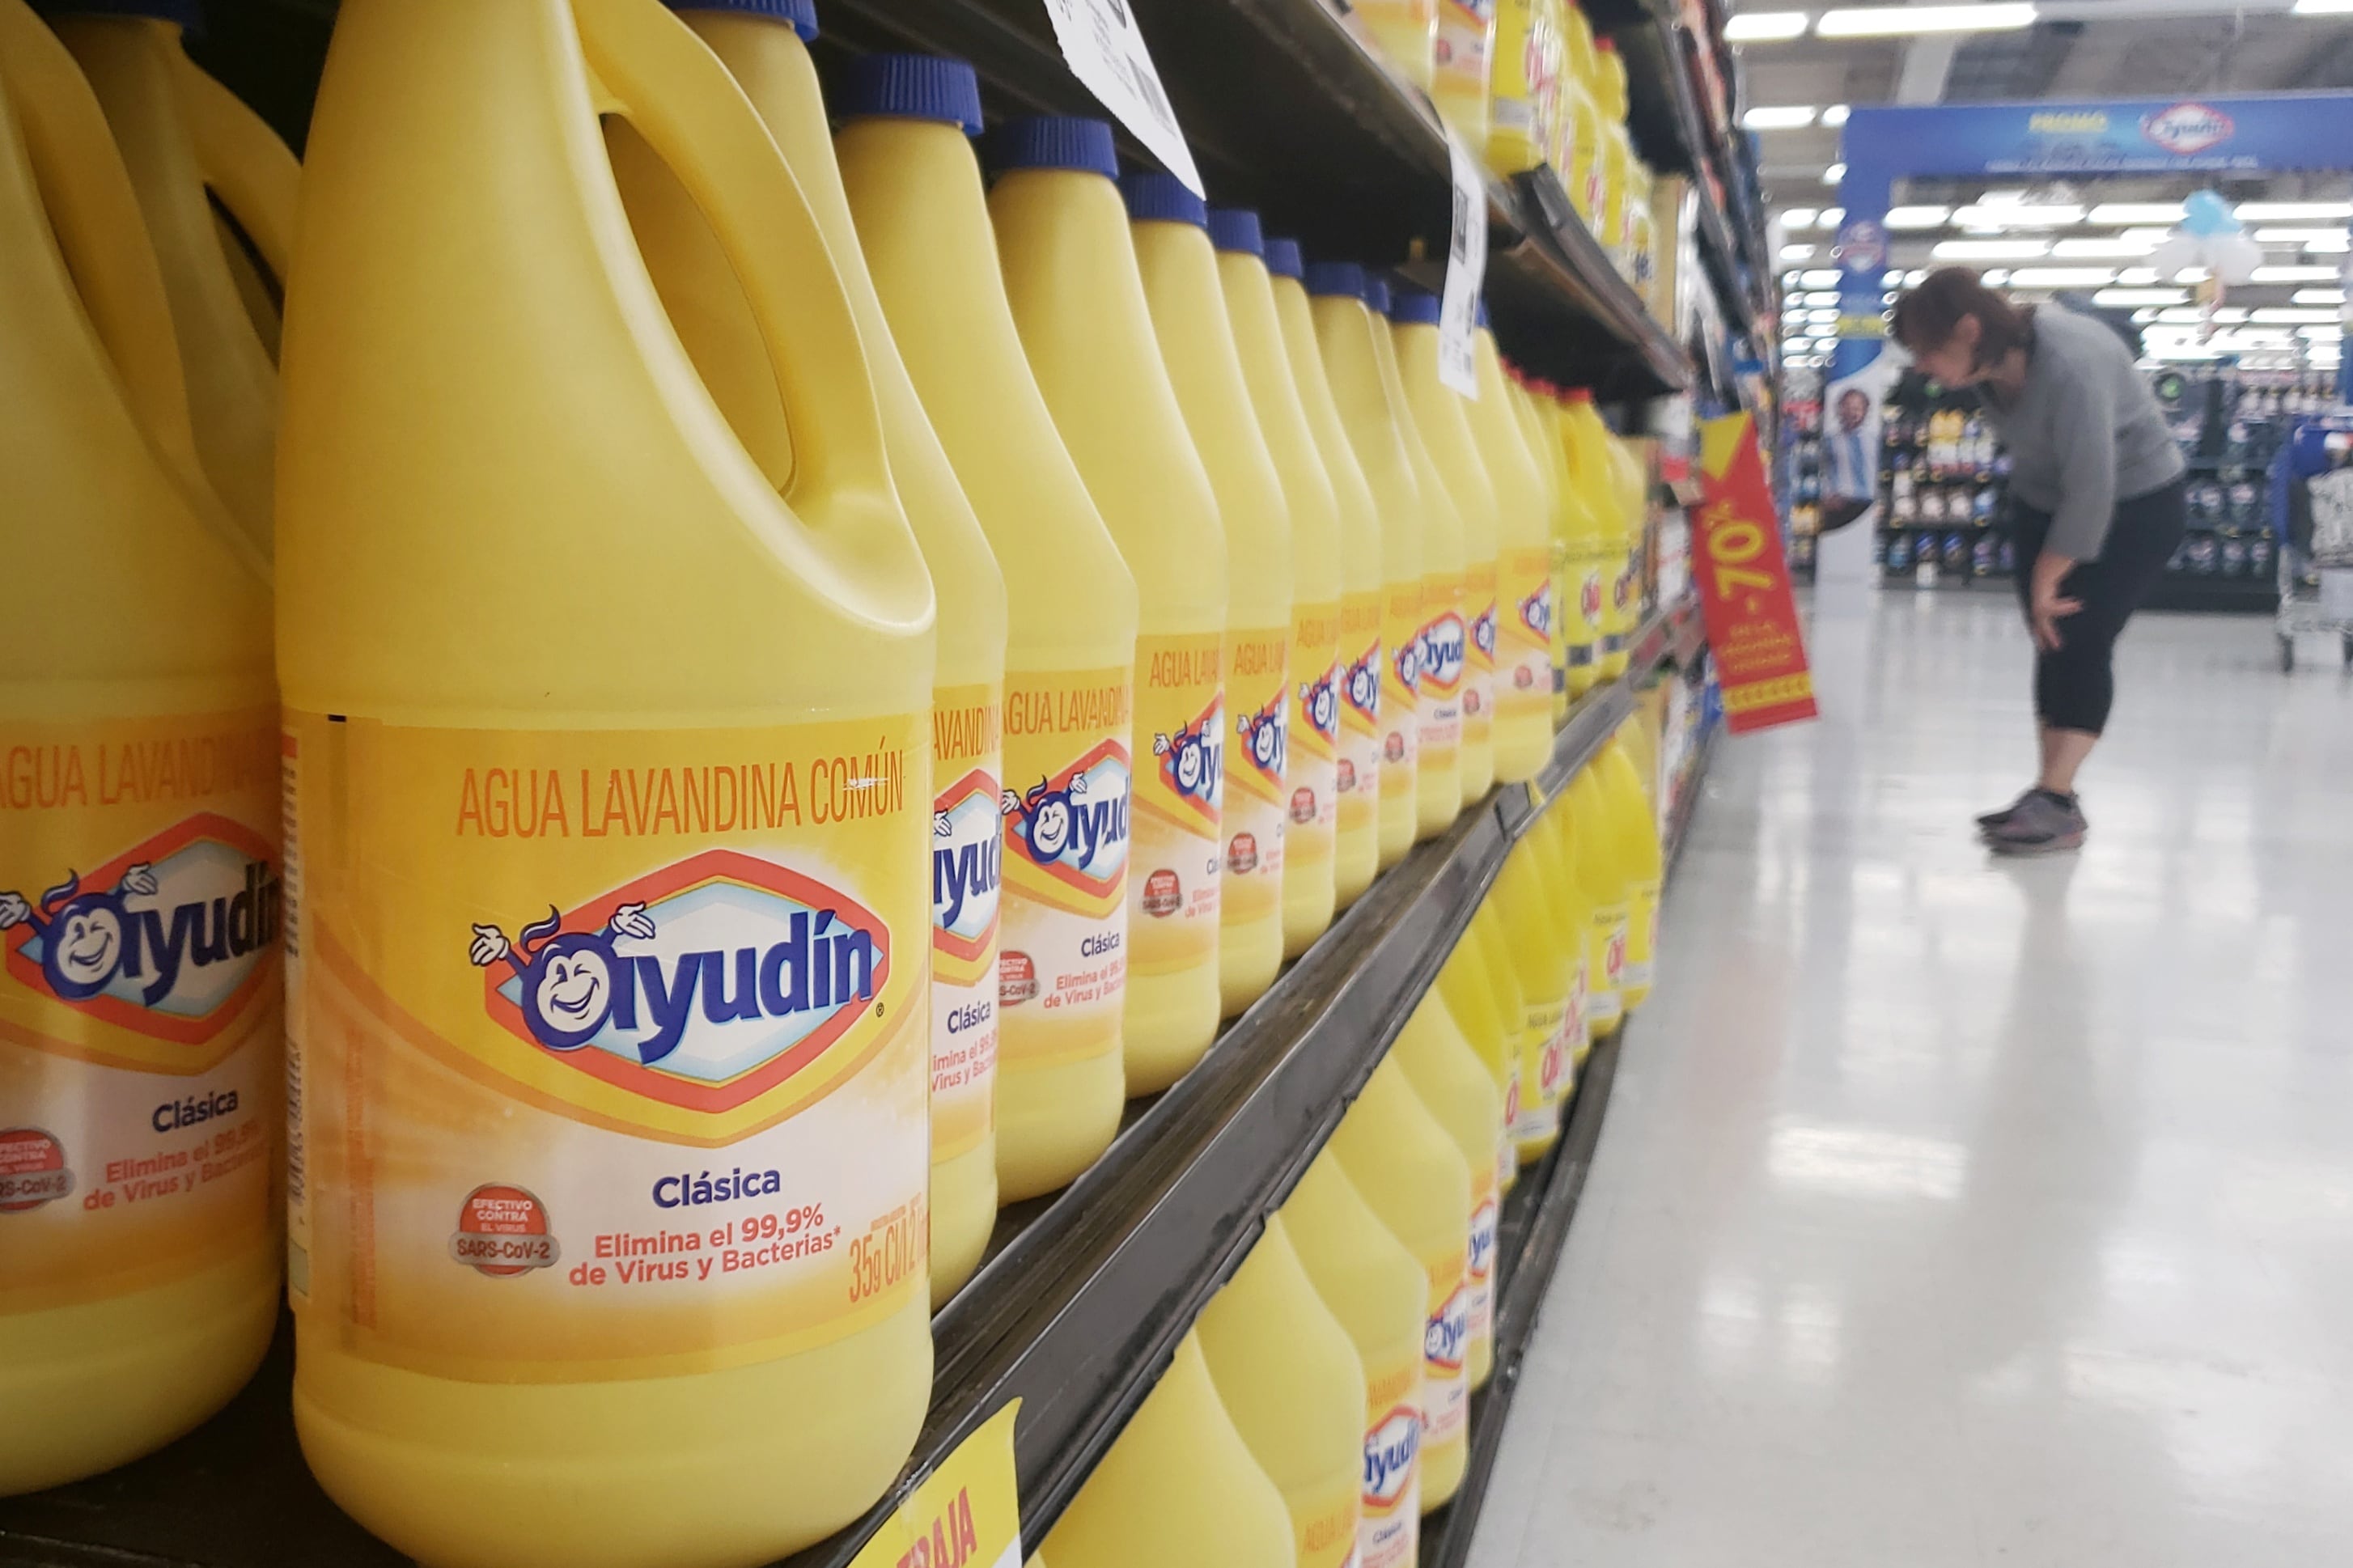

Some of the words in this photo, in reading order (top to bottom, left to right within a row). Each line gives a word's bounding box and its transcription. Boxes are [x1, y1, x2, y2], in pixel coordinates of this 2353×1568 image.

[1149, 651, 1191, 688] AGUA
[456, 767, 570, 838] AGUA
[581, 761, 803, 837] LAVANDINA
[810, 735, 904, 825] COMÚN
[1081, 930, 1121, 958] Clásica
[1044, 994, 1062, 1009] de
[1065, 987, 1093, 1005] Virus
[1057, 972, 1098, 990] Elimina
[948, 1000, 991, 1034] Clásica
[933, 1050, 966, 1072] imina
[152, 1091, 239, 1133] Clásica
[106, 1151, 188, 1184] Elimina
[193, 1140, 209, 1162] el
[83, 1188, 115, 1211] de
[124, 1176, 180, 1203] Virus
[186, 1172, 196, 1193] y
[473, 1198, 533, 1211] EFECTIVO
[652, 1168, 782, 1209] Clásica
[477, 1210, 528, 1222] CONTRA
[595, 1231, 702, 1258] Elimina
[710, 1222, 732, 1247] el
[741, 1202, 824, 1243] 99,9%
[456, 1238, 551, 1260] SARS-CoV-2
[569, 1261, 606, 1287] de
[615, 1259, 689, 1284] Virus
[697, 1257, 713, 1281] y
[850, 1233, 880, 1304] 35g
